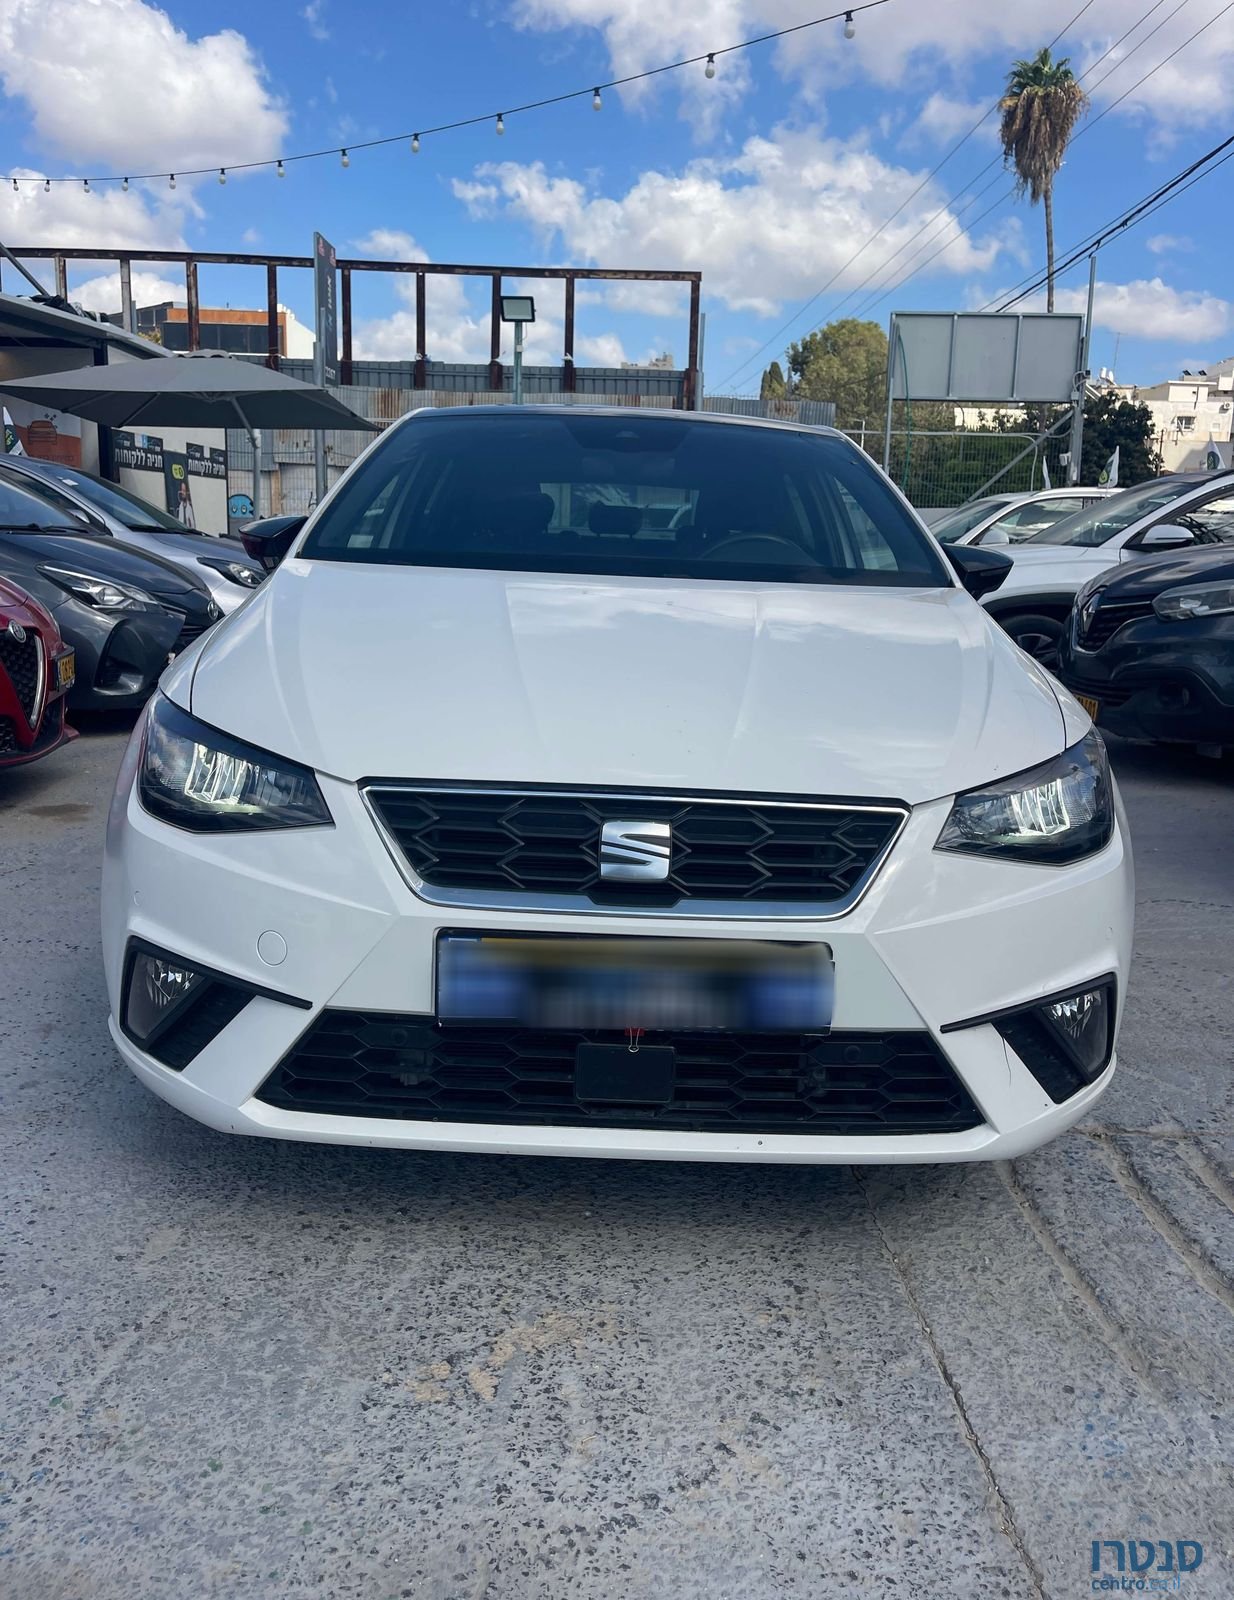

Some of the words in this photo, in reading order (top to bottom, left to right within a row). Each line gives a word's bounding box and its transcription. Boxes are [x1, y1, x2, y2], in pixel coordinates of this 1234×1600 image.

[114, 448, 146, 468] ללקוחות
[147, 453, 163, 468] חניה
[188, 458, 212, 476] ללקוחות
[212, 462, 226, 476] חניה
